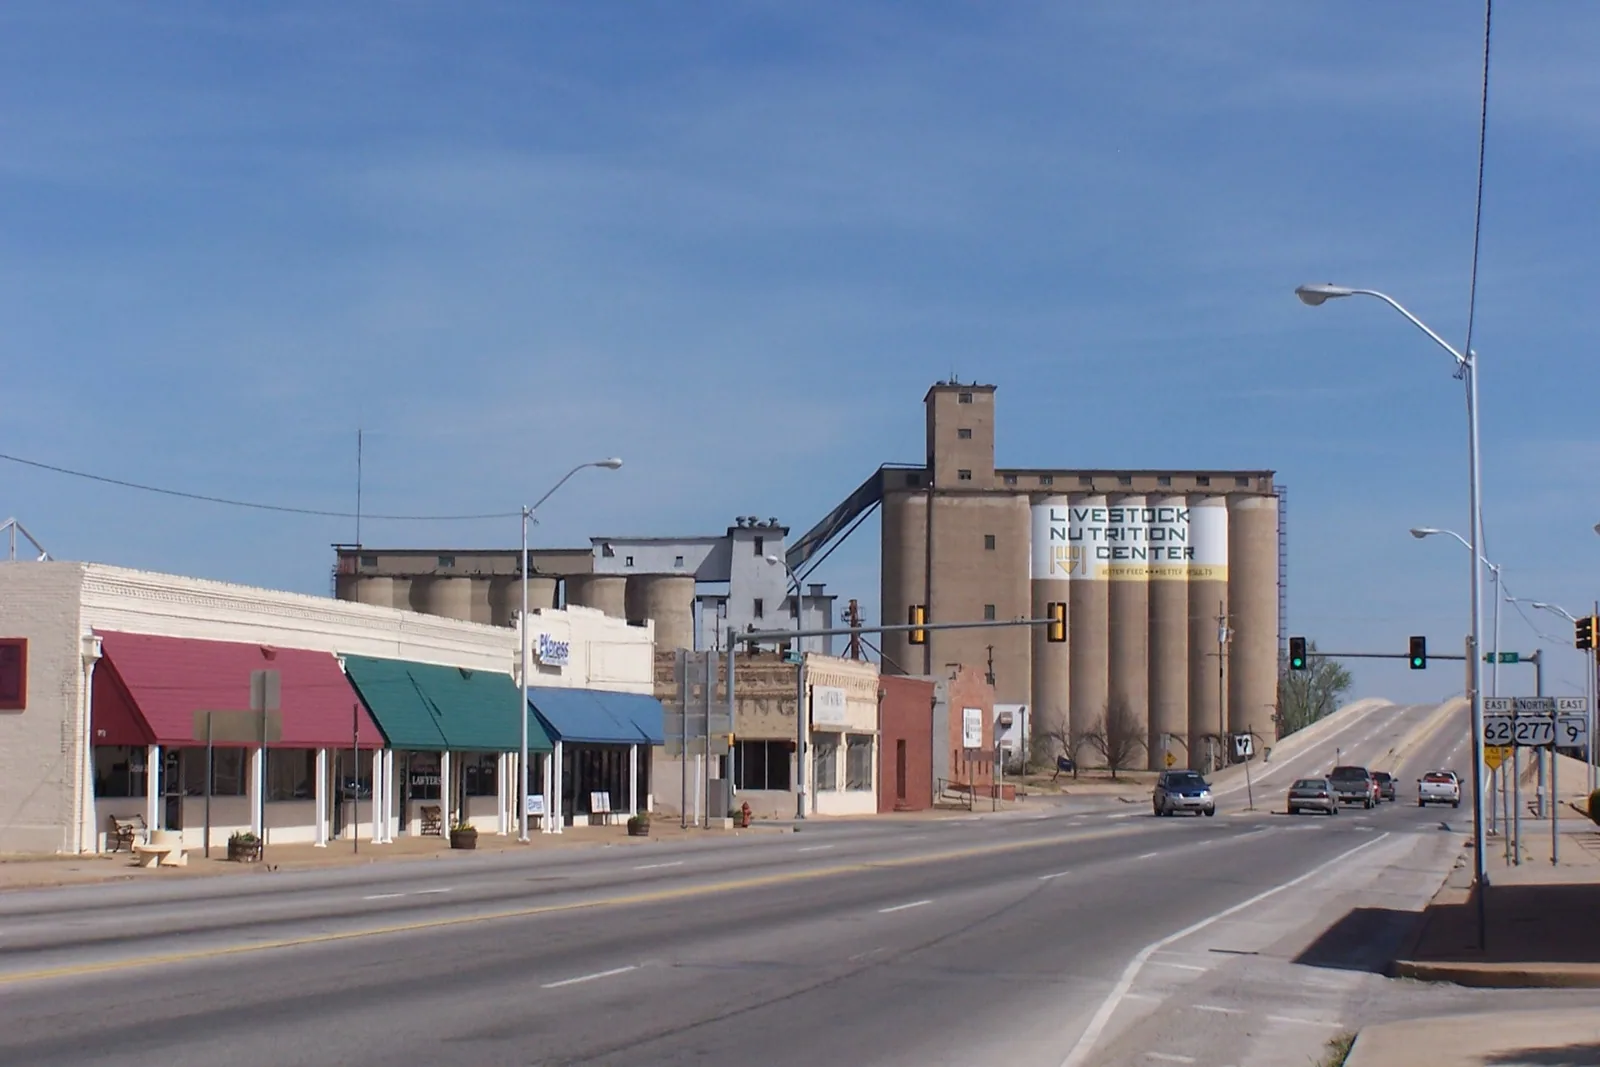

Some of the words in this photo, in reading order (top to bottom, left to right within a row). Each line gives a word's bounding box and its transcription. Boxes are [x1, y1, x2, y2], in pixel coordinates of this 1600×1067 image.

[1050, 508, 1190, 524] LIVESTOCK
[1050, 527, 1185, 541] NUTRITION
[1096, 546, 1195, 560] CENTER
[1485, 700, 1507, 710] EAST
[1520, 700, 1548, 710] NORTH
[1560, 700, 1583, 710] EAST
[1485, 722, 1509, 739] 62
[1517, 722, 1551, 739] 277
[1567, 726, 1578, 742] 9
